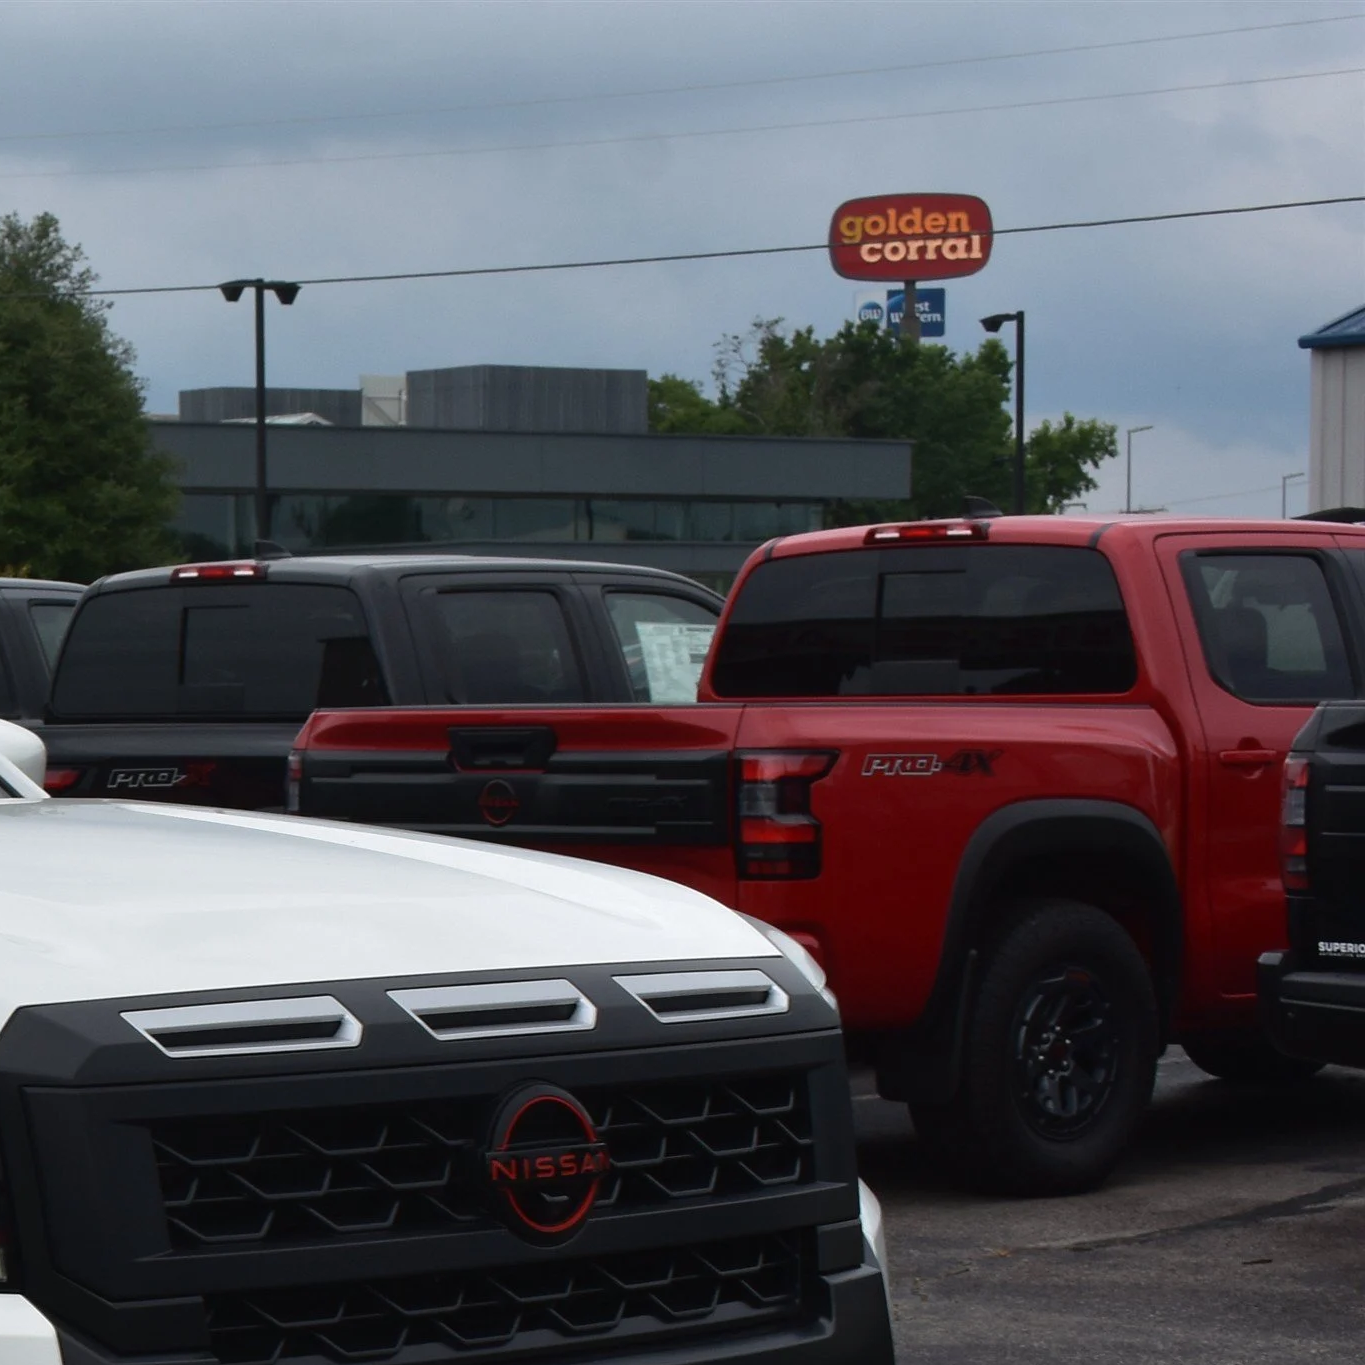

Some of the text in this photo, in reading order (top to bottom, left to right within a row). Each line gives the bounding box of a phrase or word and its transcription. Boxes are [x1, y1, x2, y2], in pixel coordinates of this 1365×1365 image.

[839, 207, 971, 244] golden
[860, 234, 983, 263] corral
[489, 1151, 611, 1181] NISSAN
